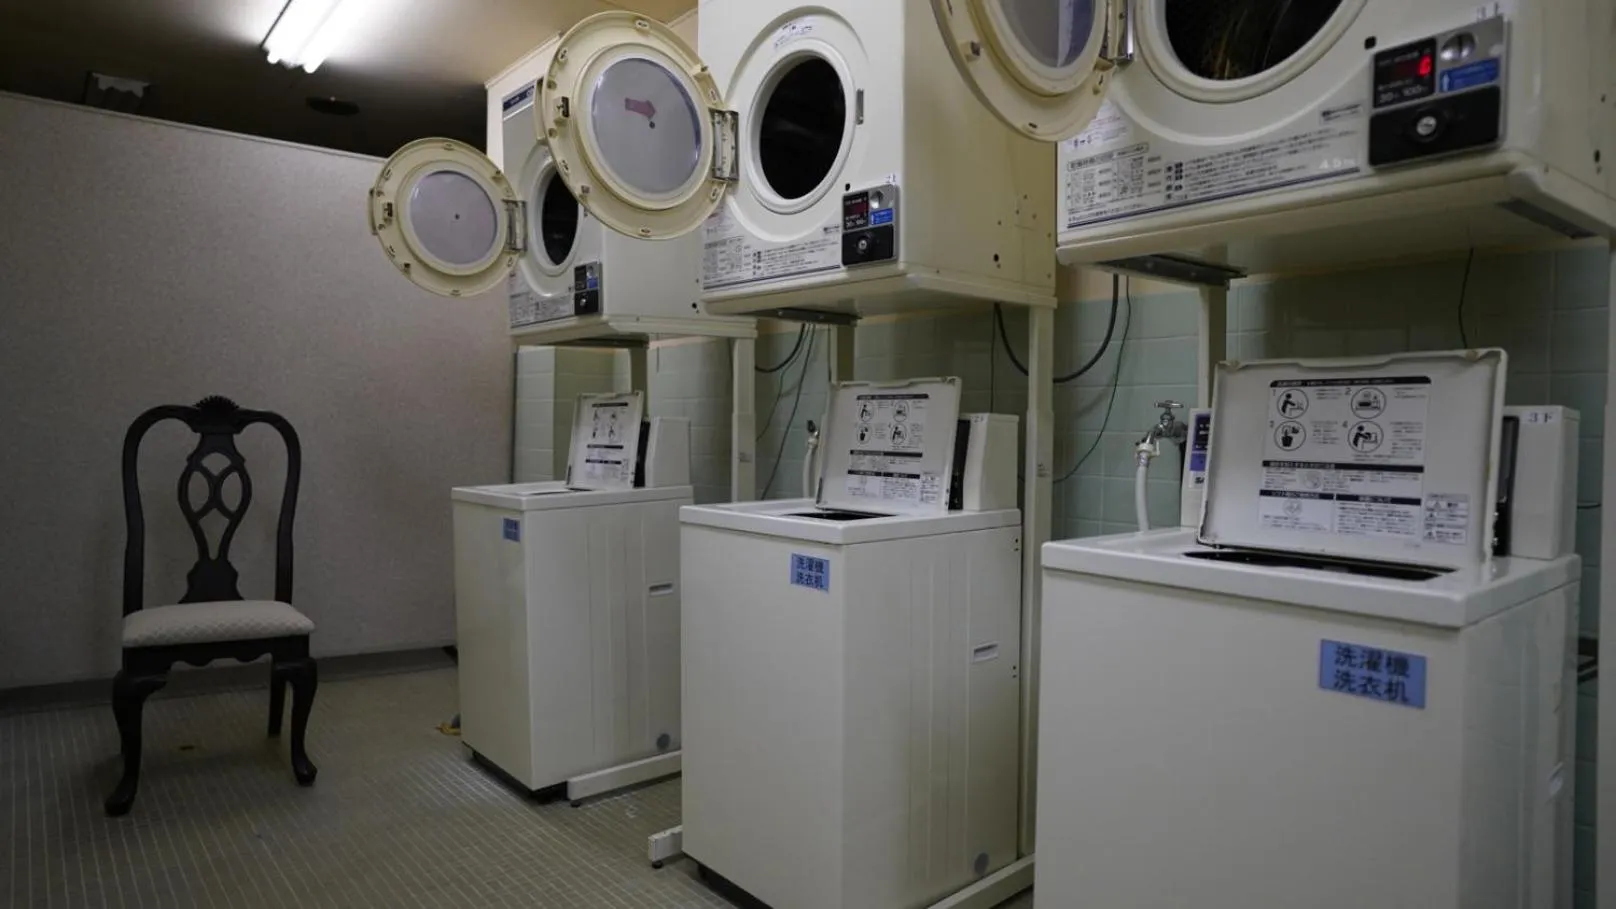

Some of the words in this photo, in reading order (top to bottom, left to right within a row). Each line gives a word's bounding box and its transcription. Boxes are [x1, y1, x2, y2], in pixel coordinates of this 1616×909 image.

[1334, 645, 1410, 678] 洗濯機
[1334, 669, 1408, 702] 洗衣机
